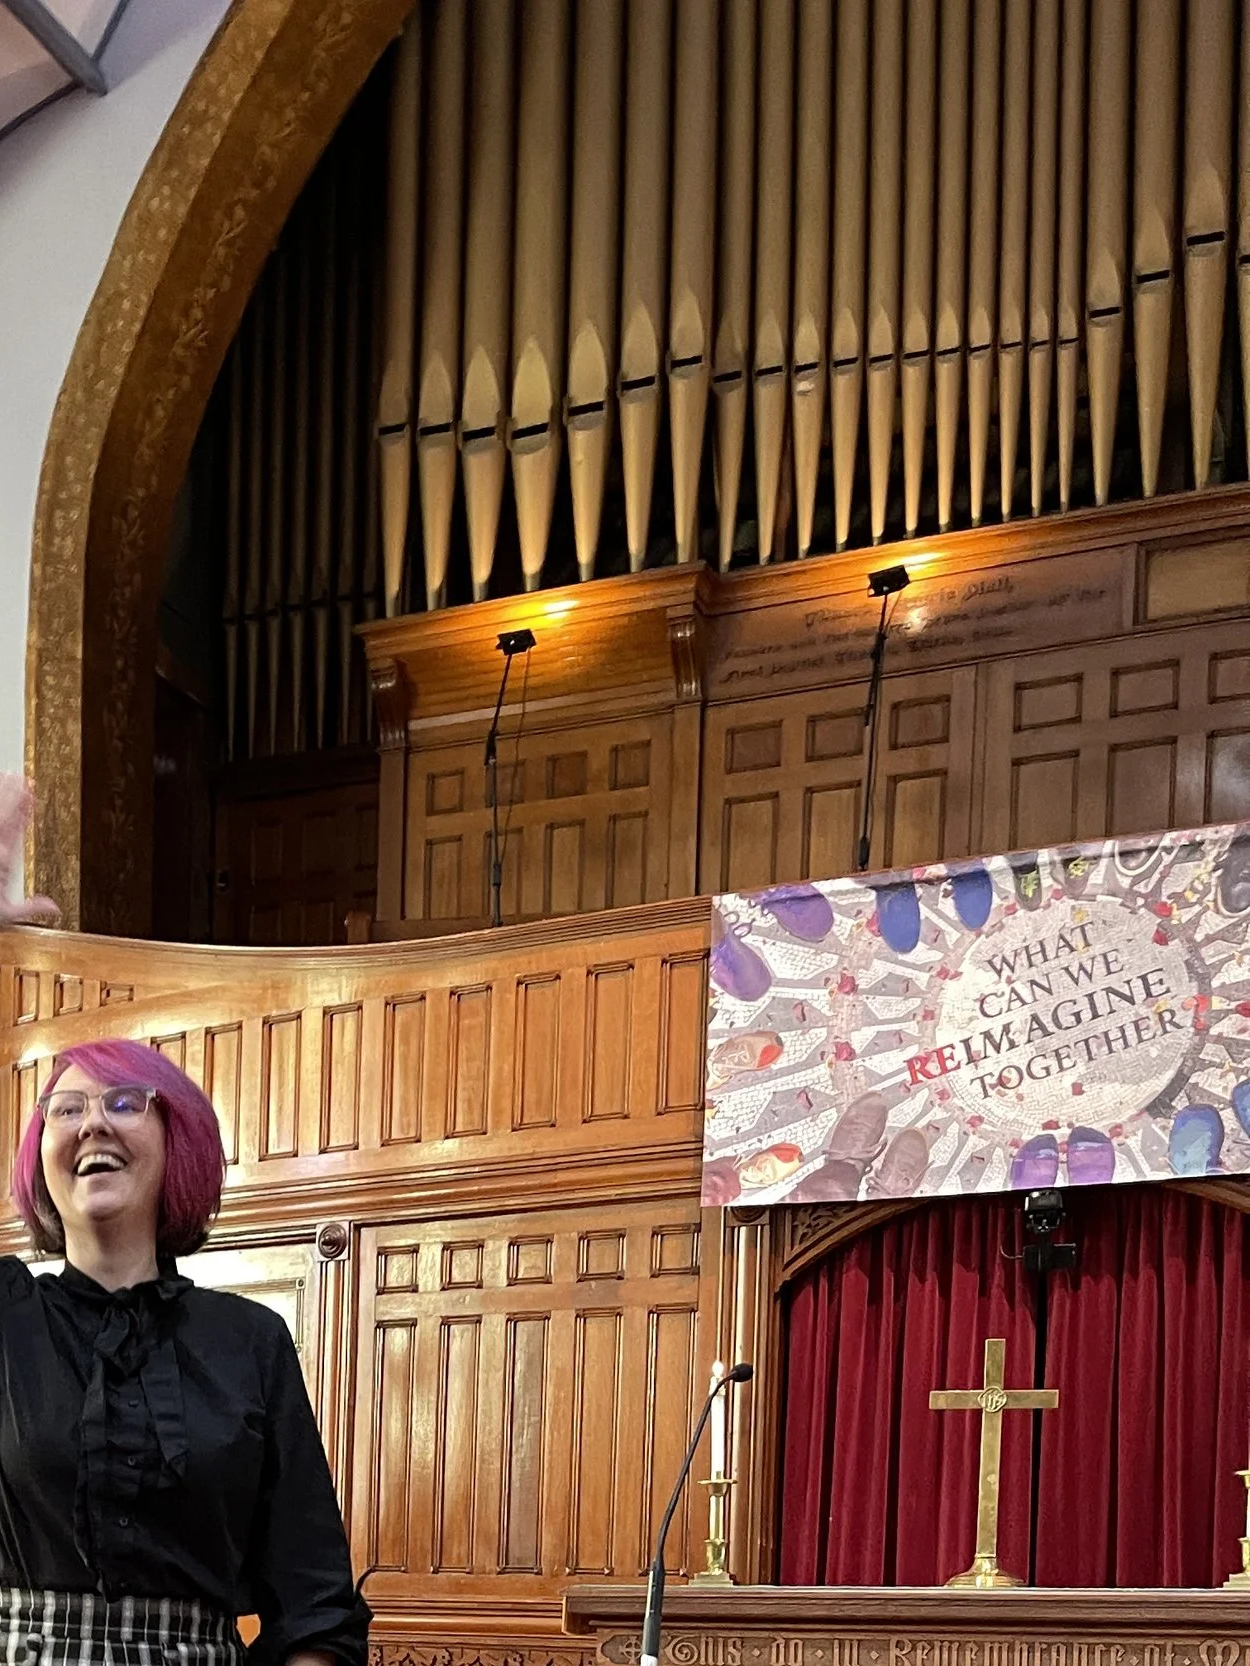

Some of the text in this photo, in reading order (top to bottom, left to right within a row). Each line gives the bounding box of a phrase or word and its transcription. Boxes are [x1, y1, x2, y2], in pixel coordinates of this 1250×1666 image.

[979, 949, 1125, 1018] CAN WE
[986, 921, 1095, 977] WHAT
[903, 967, 1172, 1086] REIMAGINE
[970, 1008, 1183, 1100] TOGETHER
[664, 1633, 745, 1666] This
